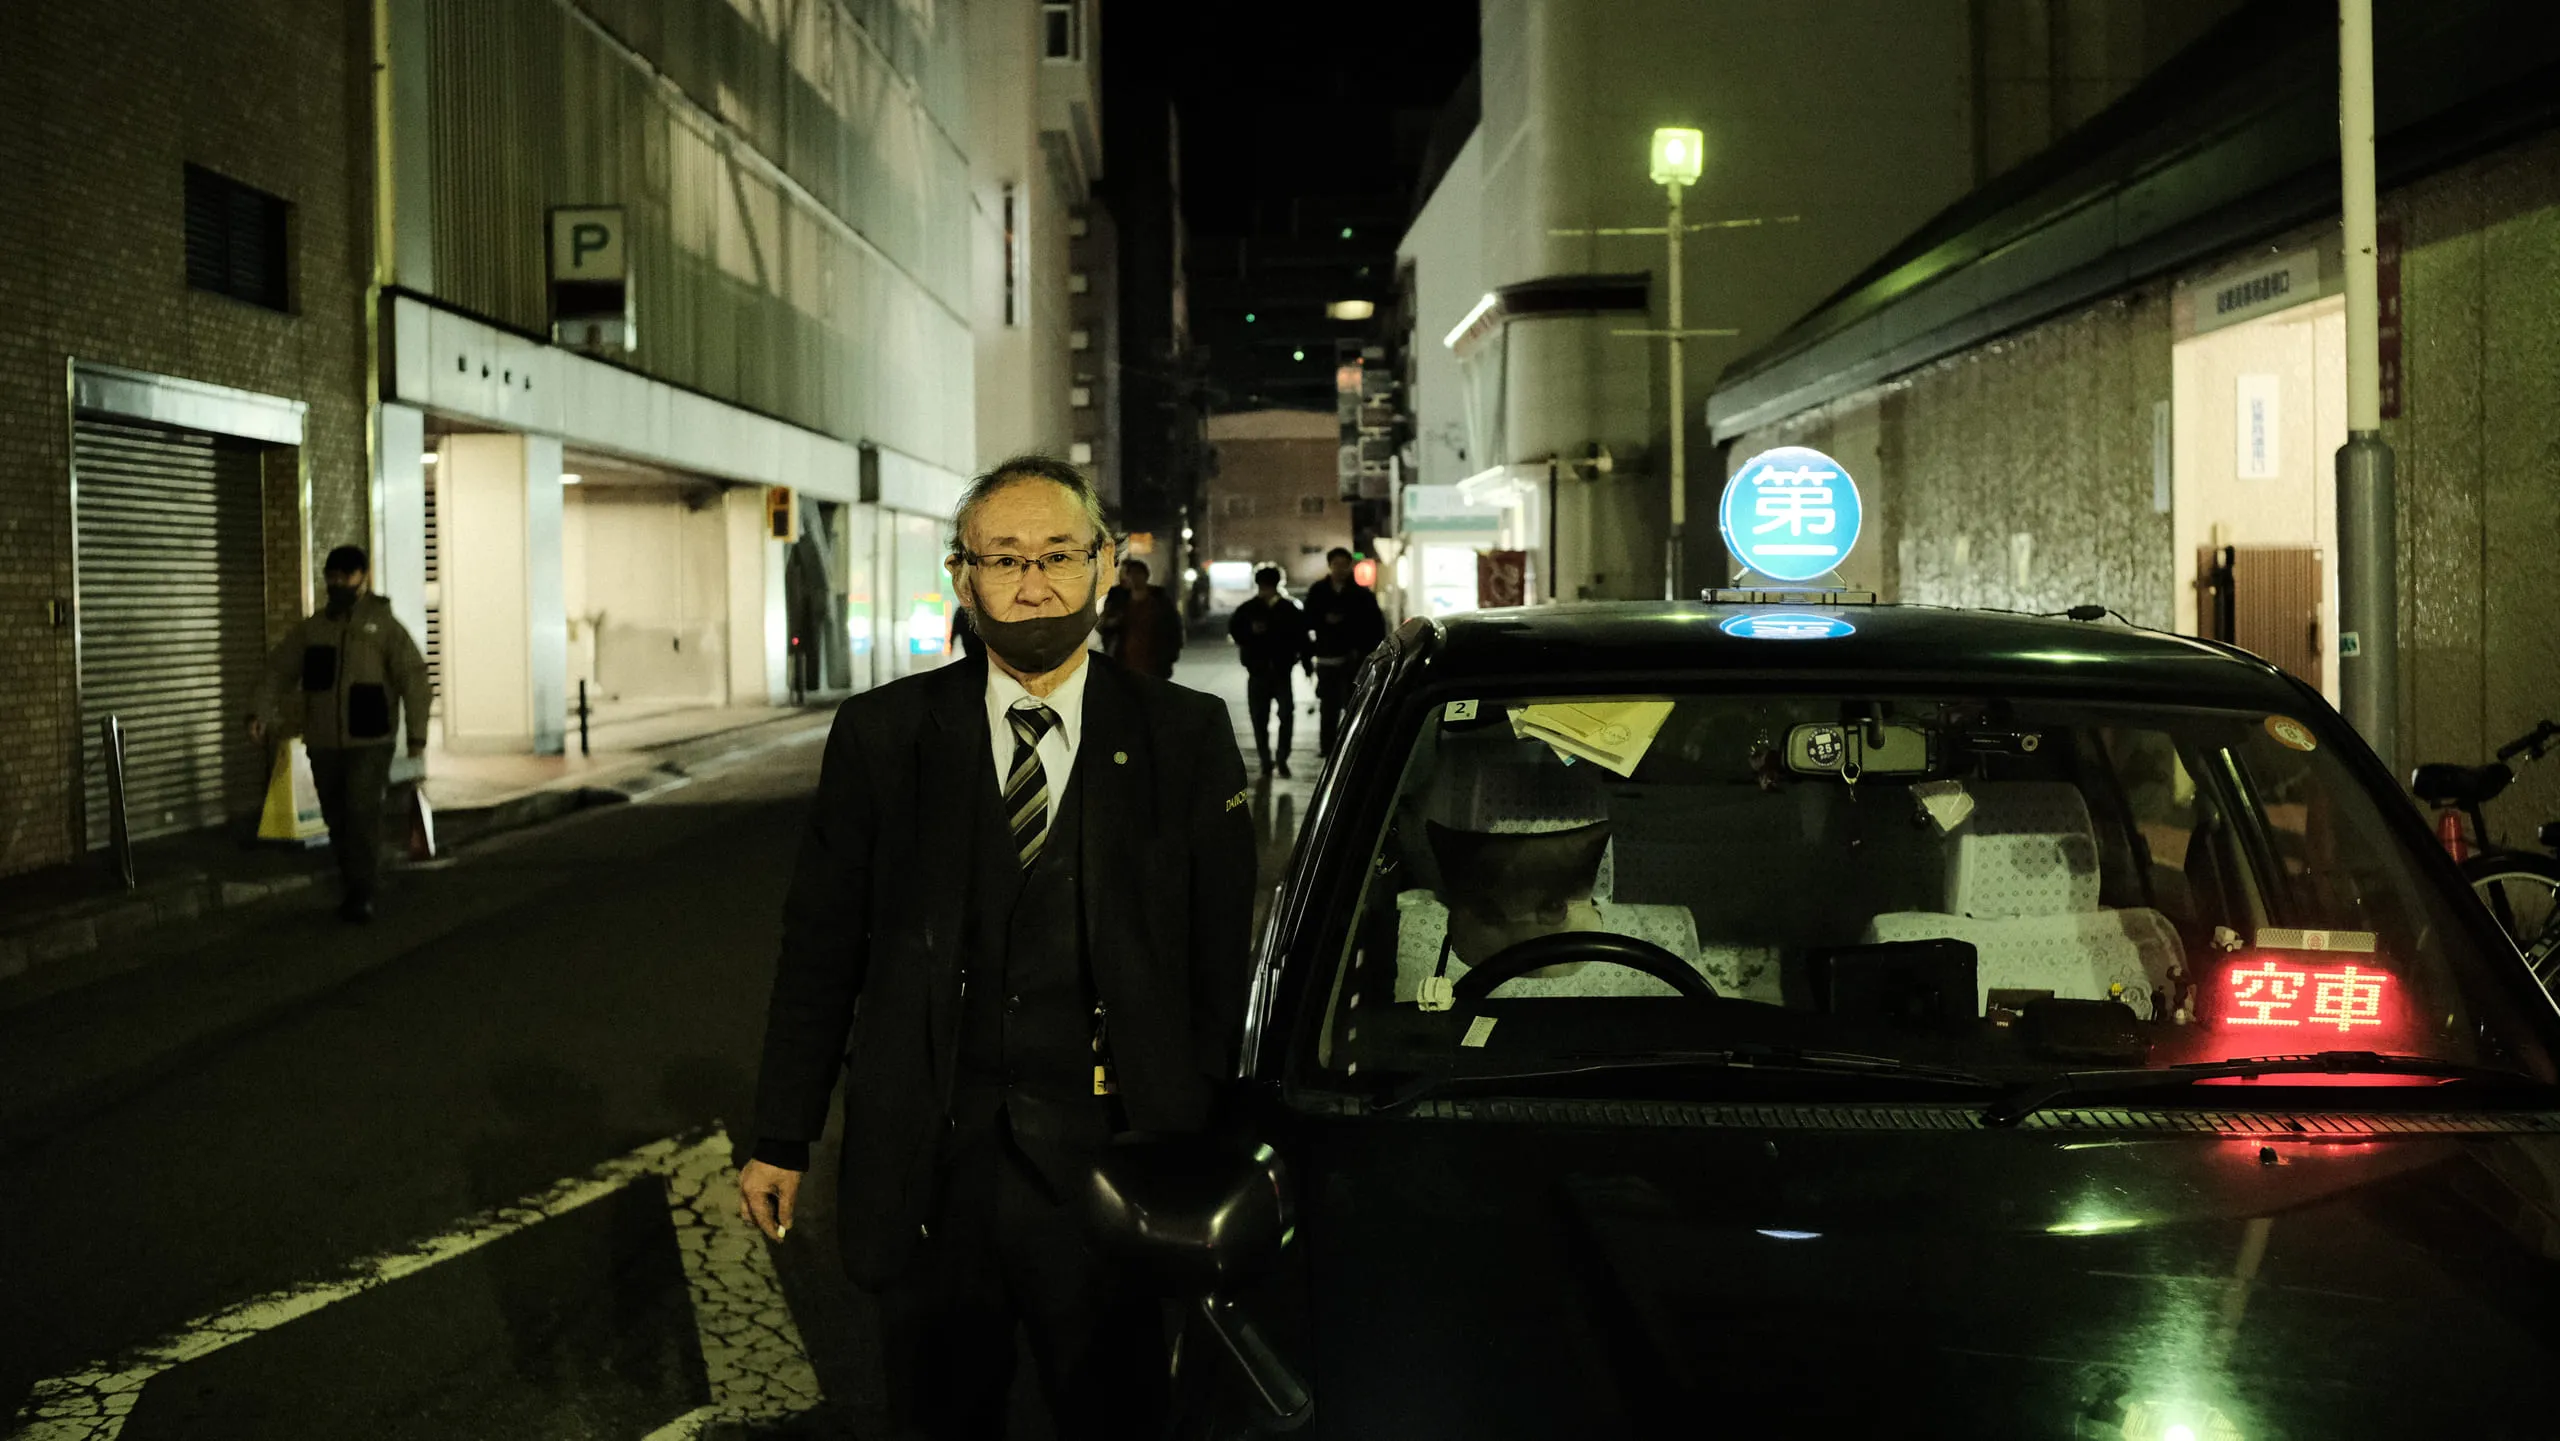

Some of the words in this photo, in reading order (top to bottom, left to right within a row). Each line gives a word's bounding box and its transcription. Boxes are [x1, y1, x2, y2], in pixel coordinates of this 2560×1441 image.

[572, 223, 610, 267] P
[1752, 465, 1838, 556] 第一
[1454, 702, 1466, 714] 2
[1817, 743, 1833, 756] 25
[2226, 961, 2387, 1032] 空車
